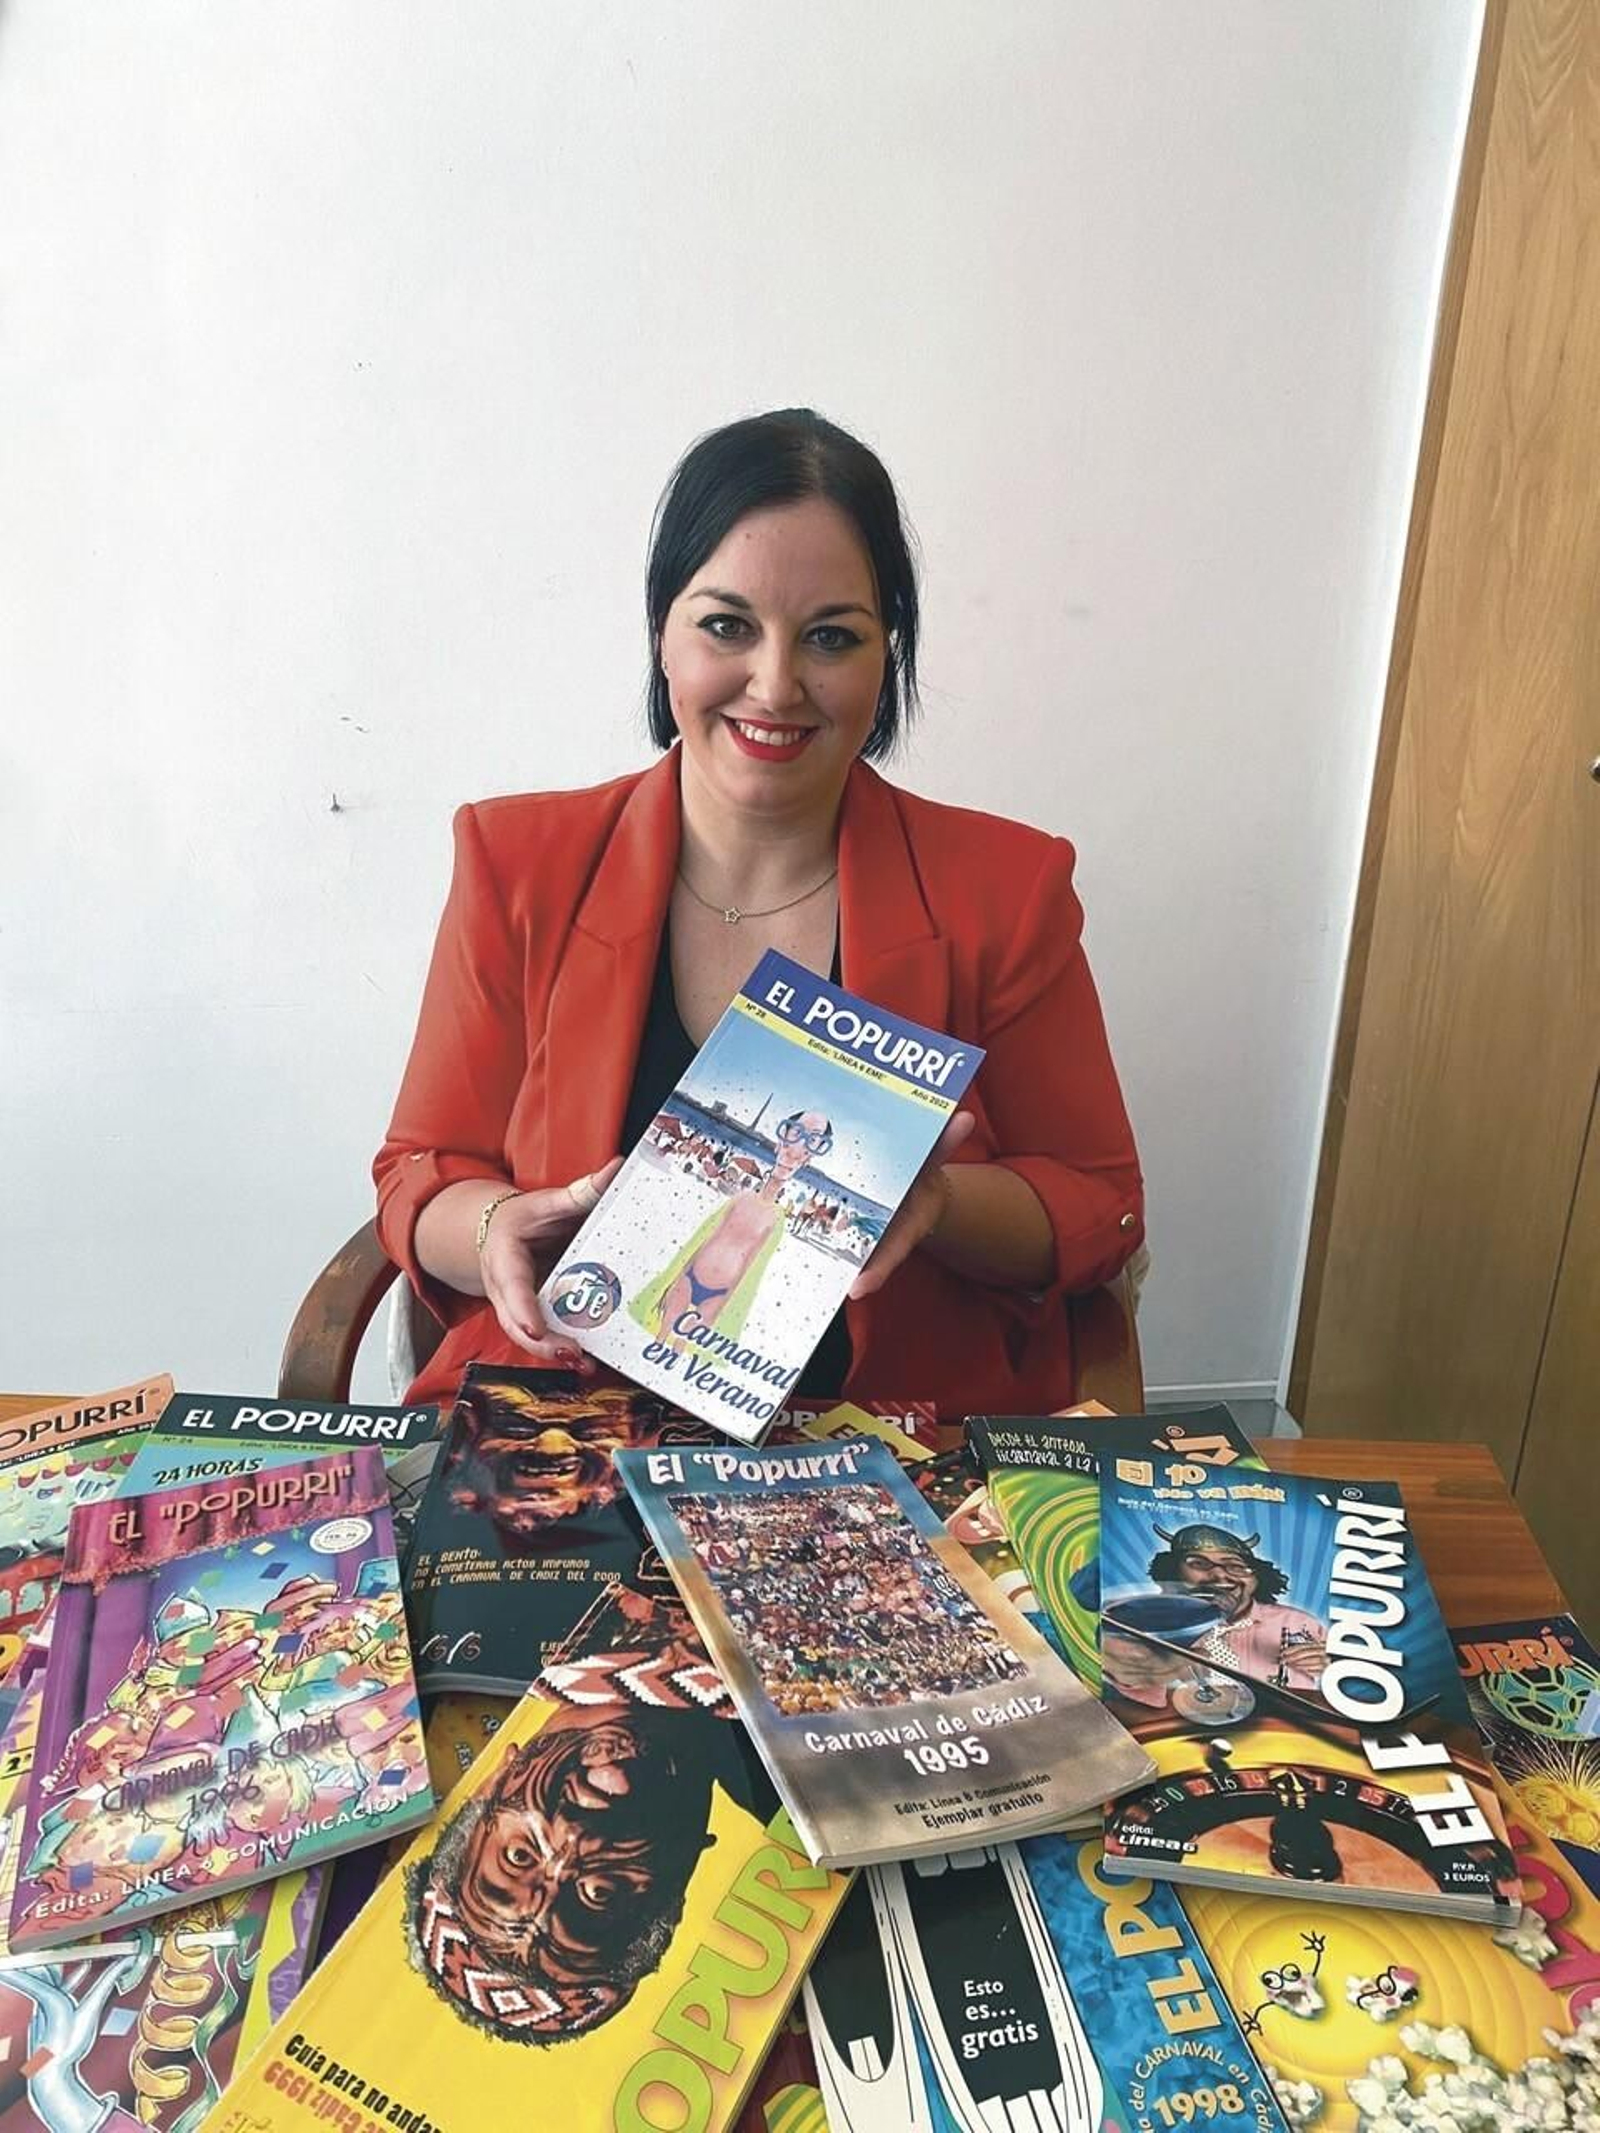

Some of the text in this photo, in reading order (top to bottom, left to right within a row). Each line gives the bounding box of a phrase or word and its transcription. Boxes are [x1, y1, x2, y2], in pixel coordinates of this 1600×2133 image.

[765, 980, 964, 1087] EL POPURRÍ
[911, 1089, 928, 1102] Año
[929, 1096, 950, 1109] 2022
[672, 1310, 800, 1390] Carnaval
[642, 1341, 775, 1420] en Verano
[0, 1388, 147, 1450] OPURRÍ
[182, 1406, 416, 1440] EL POPURRÍ
[153, 1458, 264, 1485] 24 HORAS
[646, 1453, 685, 1486] El
[1165, 1464, 1207, 1487] 10
[108, 1510, 142, 1545] EL
[418, 1555, 431, 1566] EL
[502, 1559, 536, 1569] ACTOS
[542, 1558, 591, 1569] IMPUROS
[430, 1577, 442, 1587] EL
[450, 1571, 502, 1584] CARNAVAL
[509, 1571, 525, 1581] DE
[567, 1571, 586, 1582] DEL
[593, 1572, 622, 1582] 2000
[804, 1695, 1050, 1753] Carnaval de Cádiz
[903, 1736, 989, 1776] 1995
[102, 1757, 217, 1812] CARNAVAL
[186, 1776, 261, 1812] 1996
[1334, 1780, 1348, 1796] 2
[922, 1792, 1044, 1829] Ejemplar gratuito
[1407, 1771, 1495, 1848] EL
[1121, 1824, 1155, 1836] edita:
[1444, 1872, 1491, 1884] 3 EUROS
[35, 1890, 110, 1918] Edita:
[964, 1980, 1004, 1998] Esto
[1147, 1958, 1221, 2035] EL
[965, 2003, 1016, 2021] es...
[961, 2020, 1039, 2059] gratis
[285, 2034, 327, 2074] Guía
[320, 2062, 367, 2099] para
[363, 2087, 389, 2114] no
[1136, 2041, 1224, 2079] CARNAVAL
[1228, 2064, 1249, 2085] en
[1129, 2081, 1146, 2111] del
[1153, 2084, 1244, 2127] 1998
